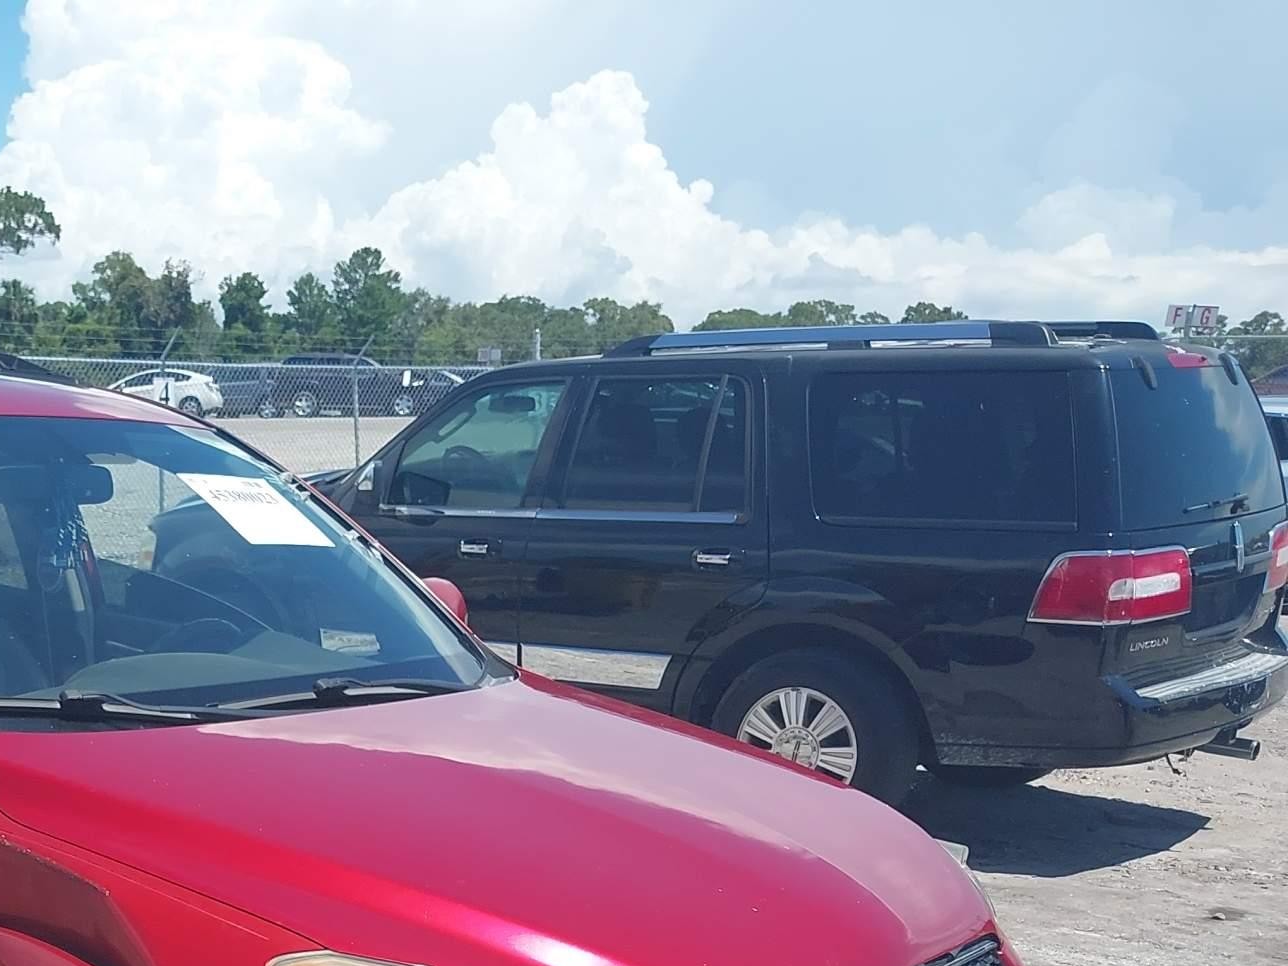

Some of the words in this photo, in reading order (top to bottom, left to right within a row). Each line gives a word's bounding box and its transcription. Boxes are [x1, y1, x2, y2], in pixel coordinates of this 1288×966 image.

[1173, 307, 1183, 325] F
[1200, 308, 1211, 325] G
[159, 381, 170, 405] 4
[1129, 636, 1169, 652] LINCOLN
